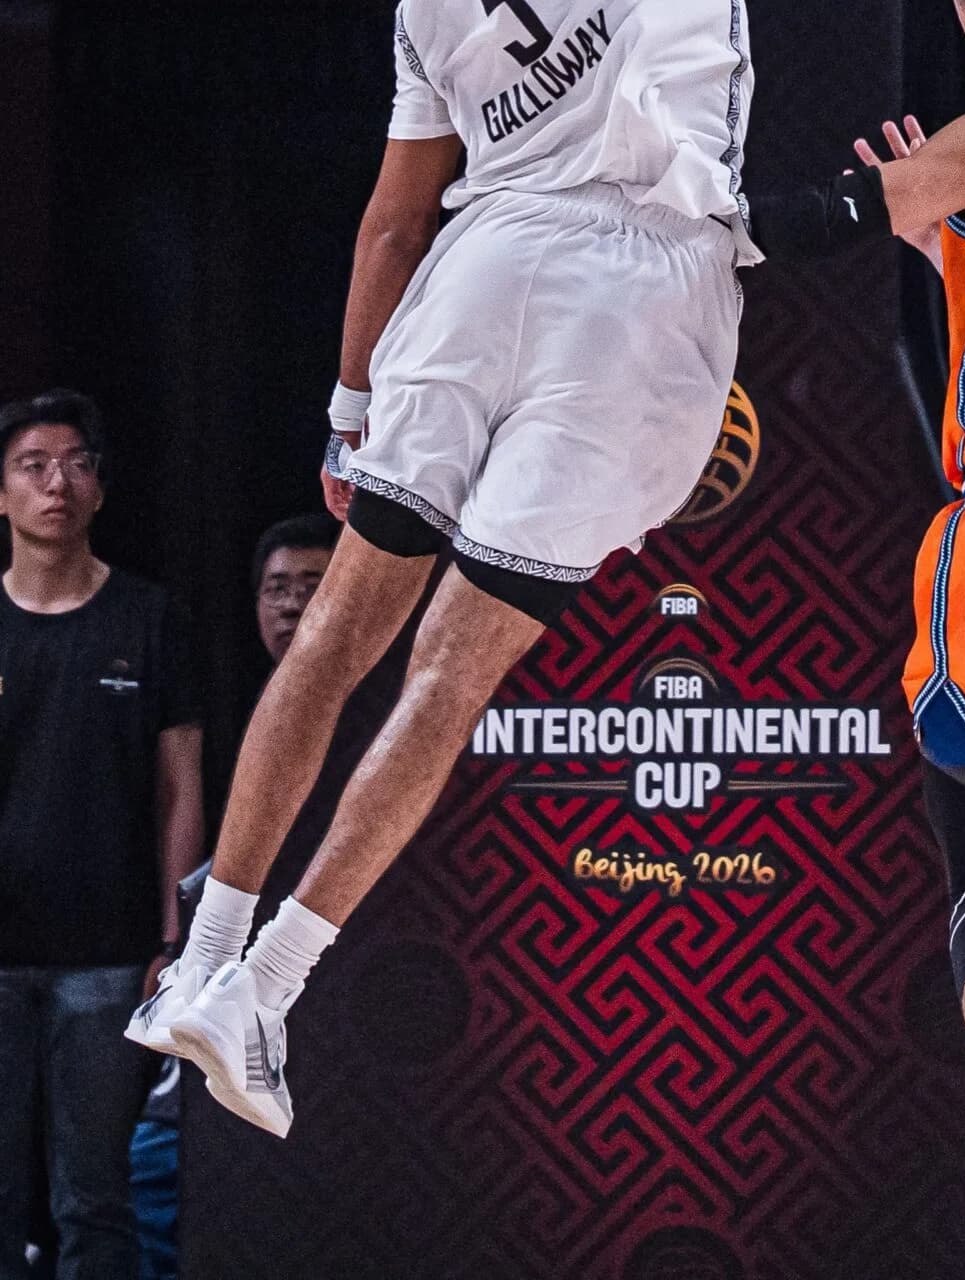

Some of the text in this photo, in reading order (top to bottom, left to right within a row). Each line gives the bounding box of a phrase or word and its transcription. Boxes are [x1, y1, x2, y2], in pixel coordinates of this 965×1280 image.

[481, 8, 611, 144] GALLOWAY
[661, 596, 698, 615] FIBA
[654, 675, 703, 699] FIBA
[473, 707, 891, 754] INTERCONTINENTAL
[634, 762, 721, 808] CUP
[574, 847, 775, 896] Beijing 2026
